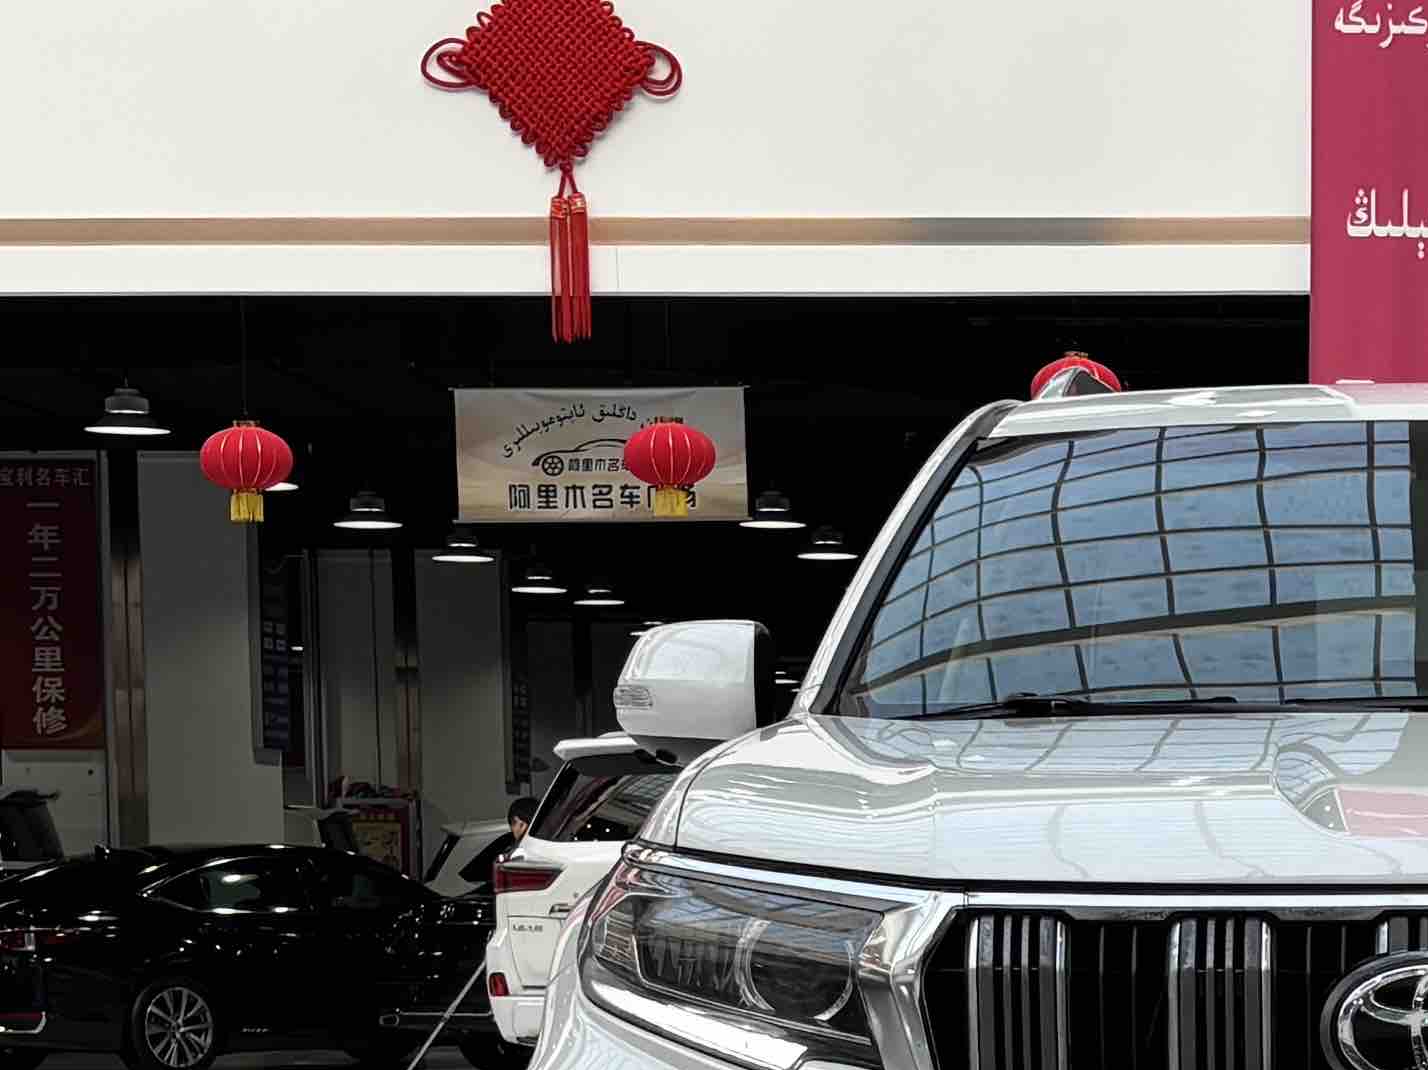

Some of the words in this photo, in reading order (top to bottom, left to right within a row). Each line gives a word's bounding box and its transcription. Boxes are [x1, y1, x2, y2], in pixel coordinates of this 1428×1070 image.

[26, 500, 67, 736] 一年二万公里保修
